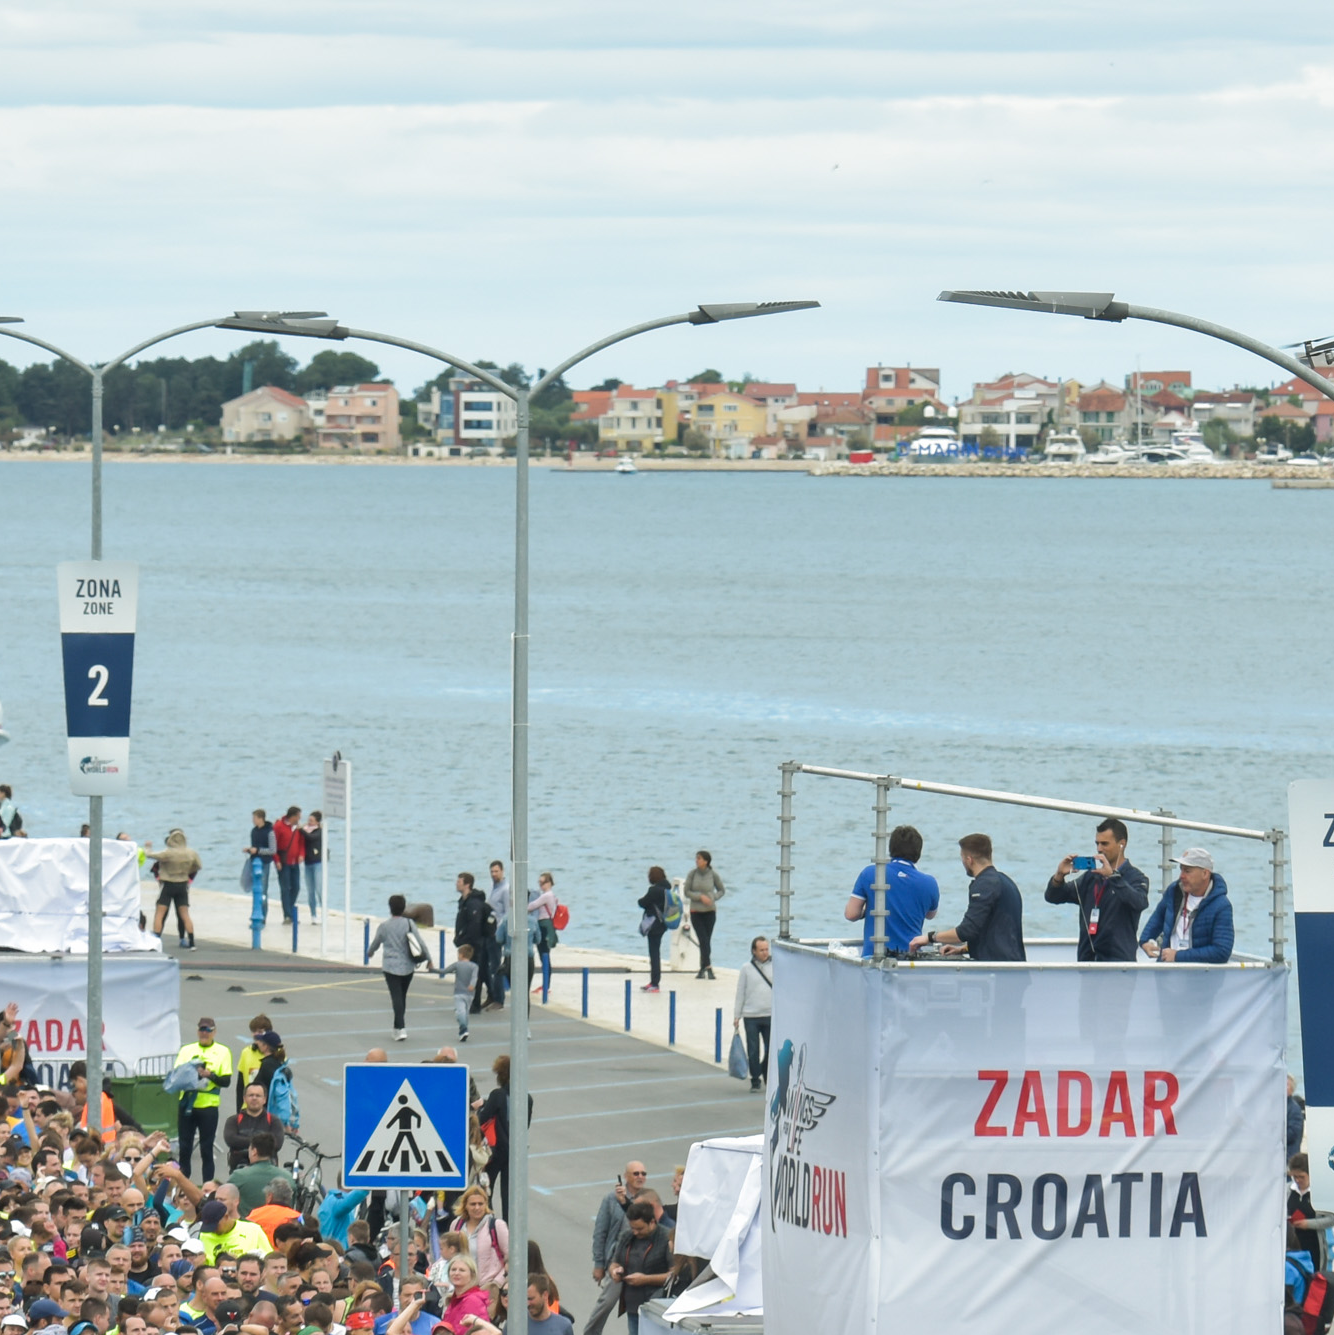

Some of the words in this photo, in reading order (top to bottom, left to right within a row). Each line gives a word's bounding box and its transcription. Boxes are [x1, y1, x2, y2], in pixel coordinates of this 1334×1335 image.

[75, 579, 122, 598] ZONA
[83, 602, 114, 615] ZONE
[87, 664, 109, 706] 2
[974, 1070, 1180, 1138] ZADAR
[811, 1165, 847, 1239] RUN
[939, 1170, 1208, 1241] CROATIA
